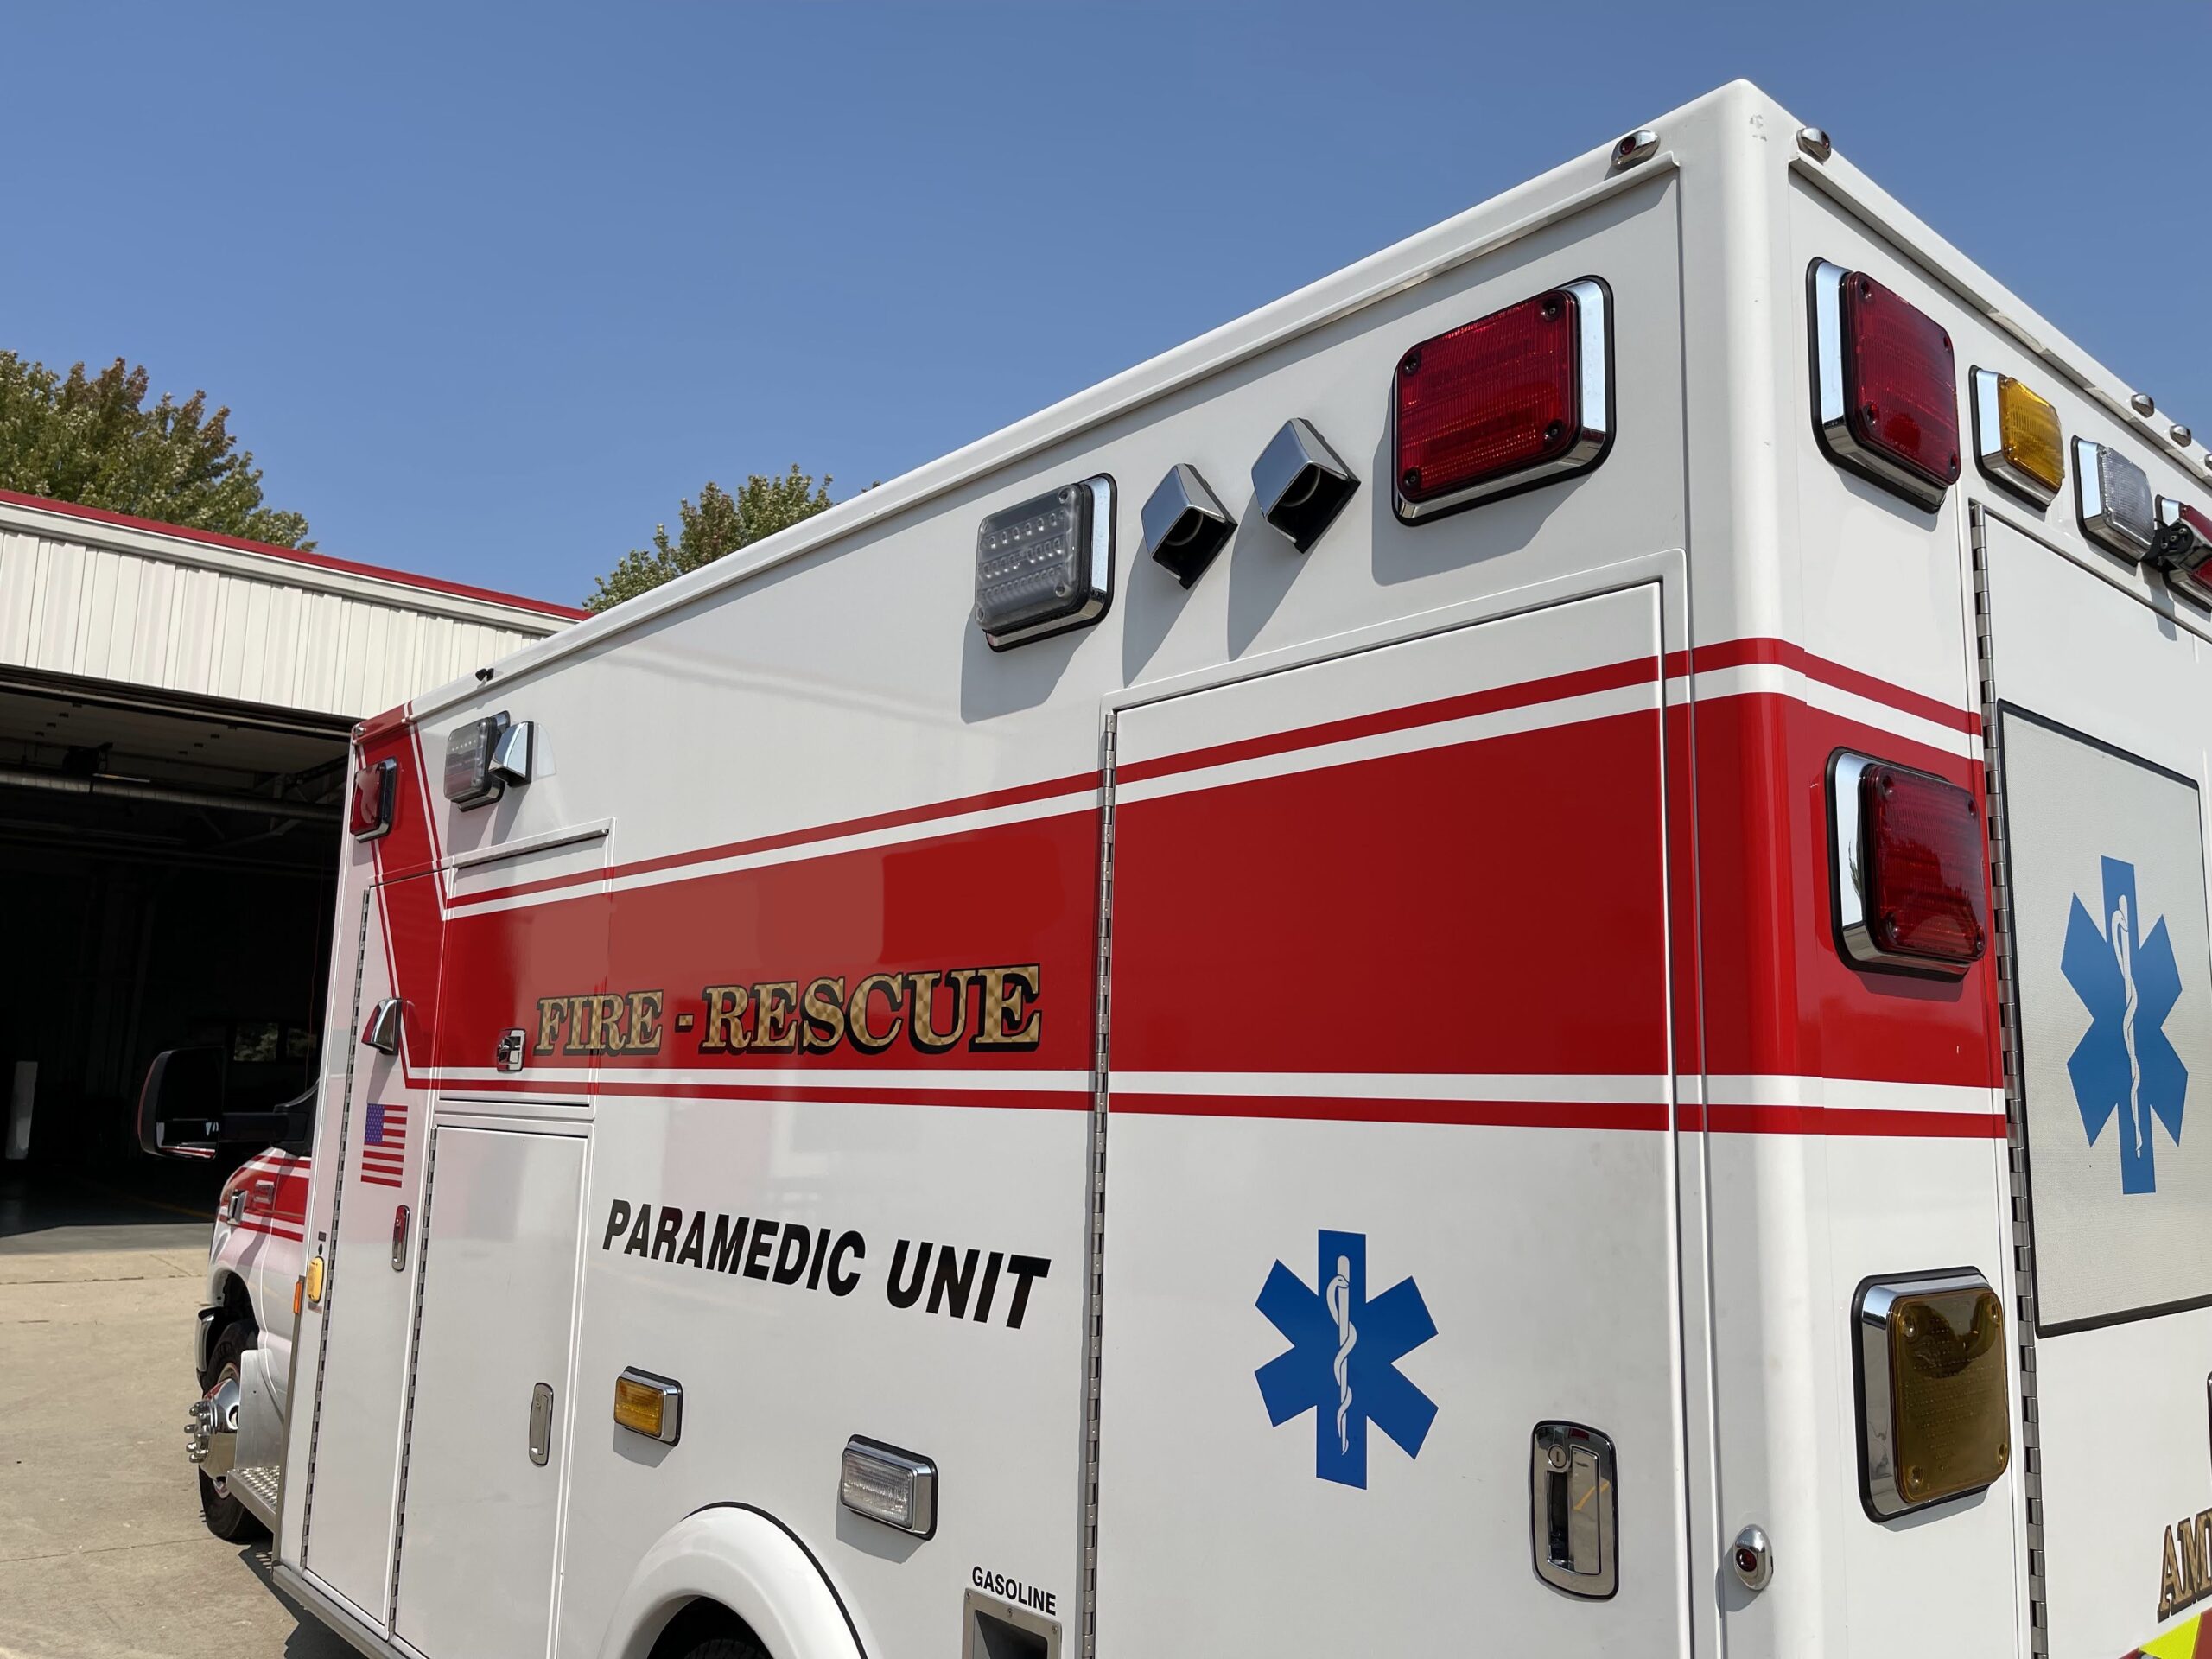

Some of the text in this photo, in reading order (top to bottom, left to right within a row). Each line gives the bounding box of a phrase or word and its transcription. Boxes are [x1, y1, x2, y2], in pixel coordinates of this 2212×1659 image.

[533, 989, 664, 1055] FIRE
[698, 963, 1042, 1054] RESCUE
[602, 1198, 1052, 1329] PARAMEDIC UNIT
[972, 1566, 1057, 1617] GASOLINE
[2157, 1507, 2212, 1624] AM
